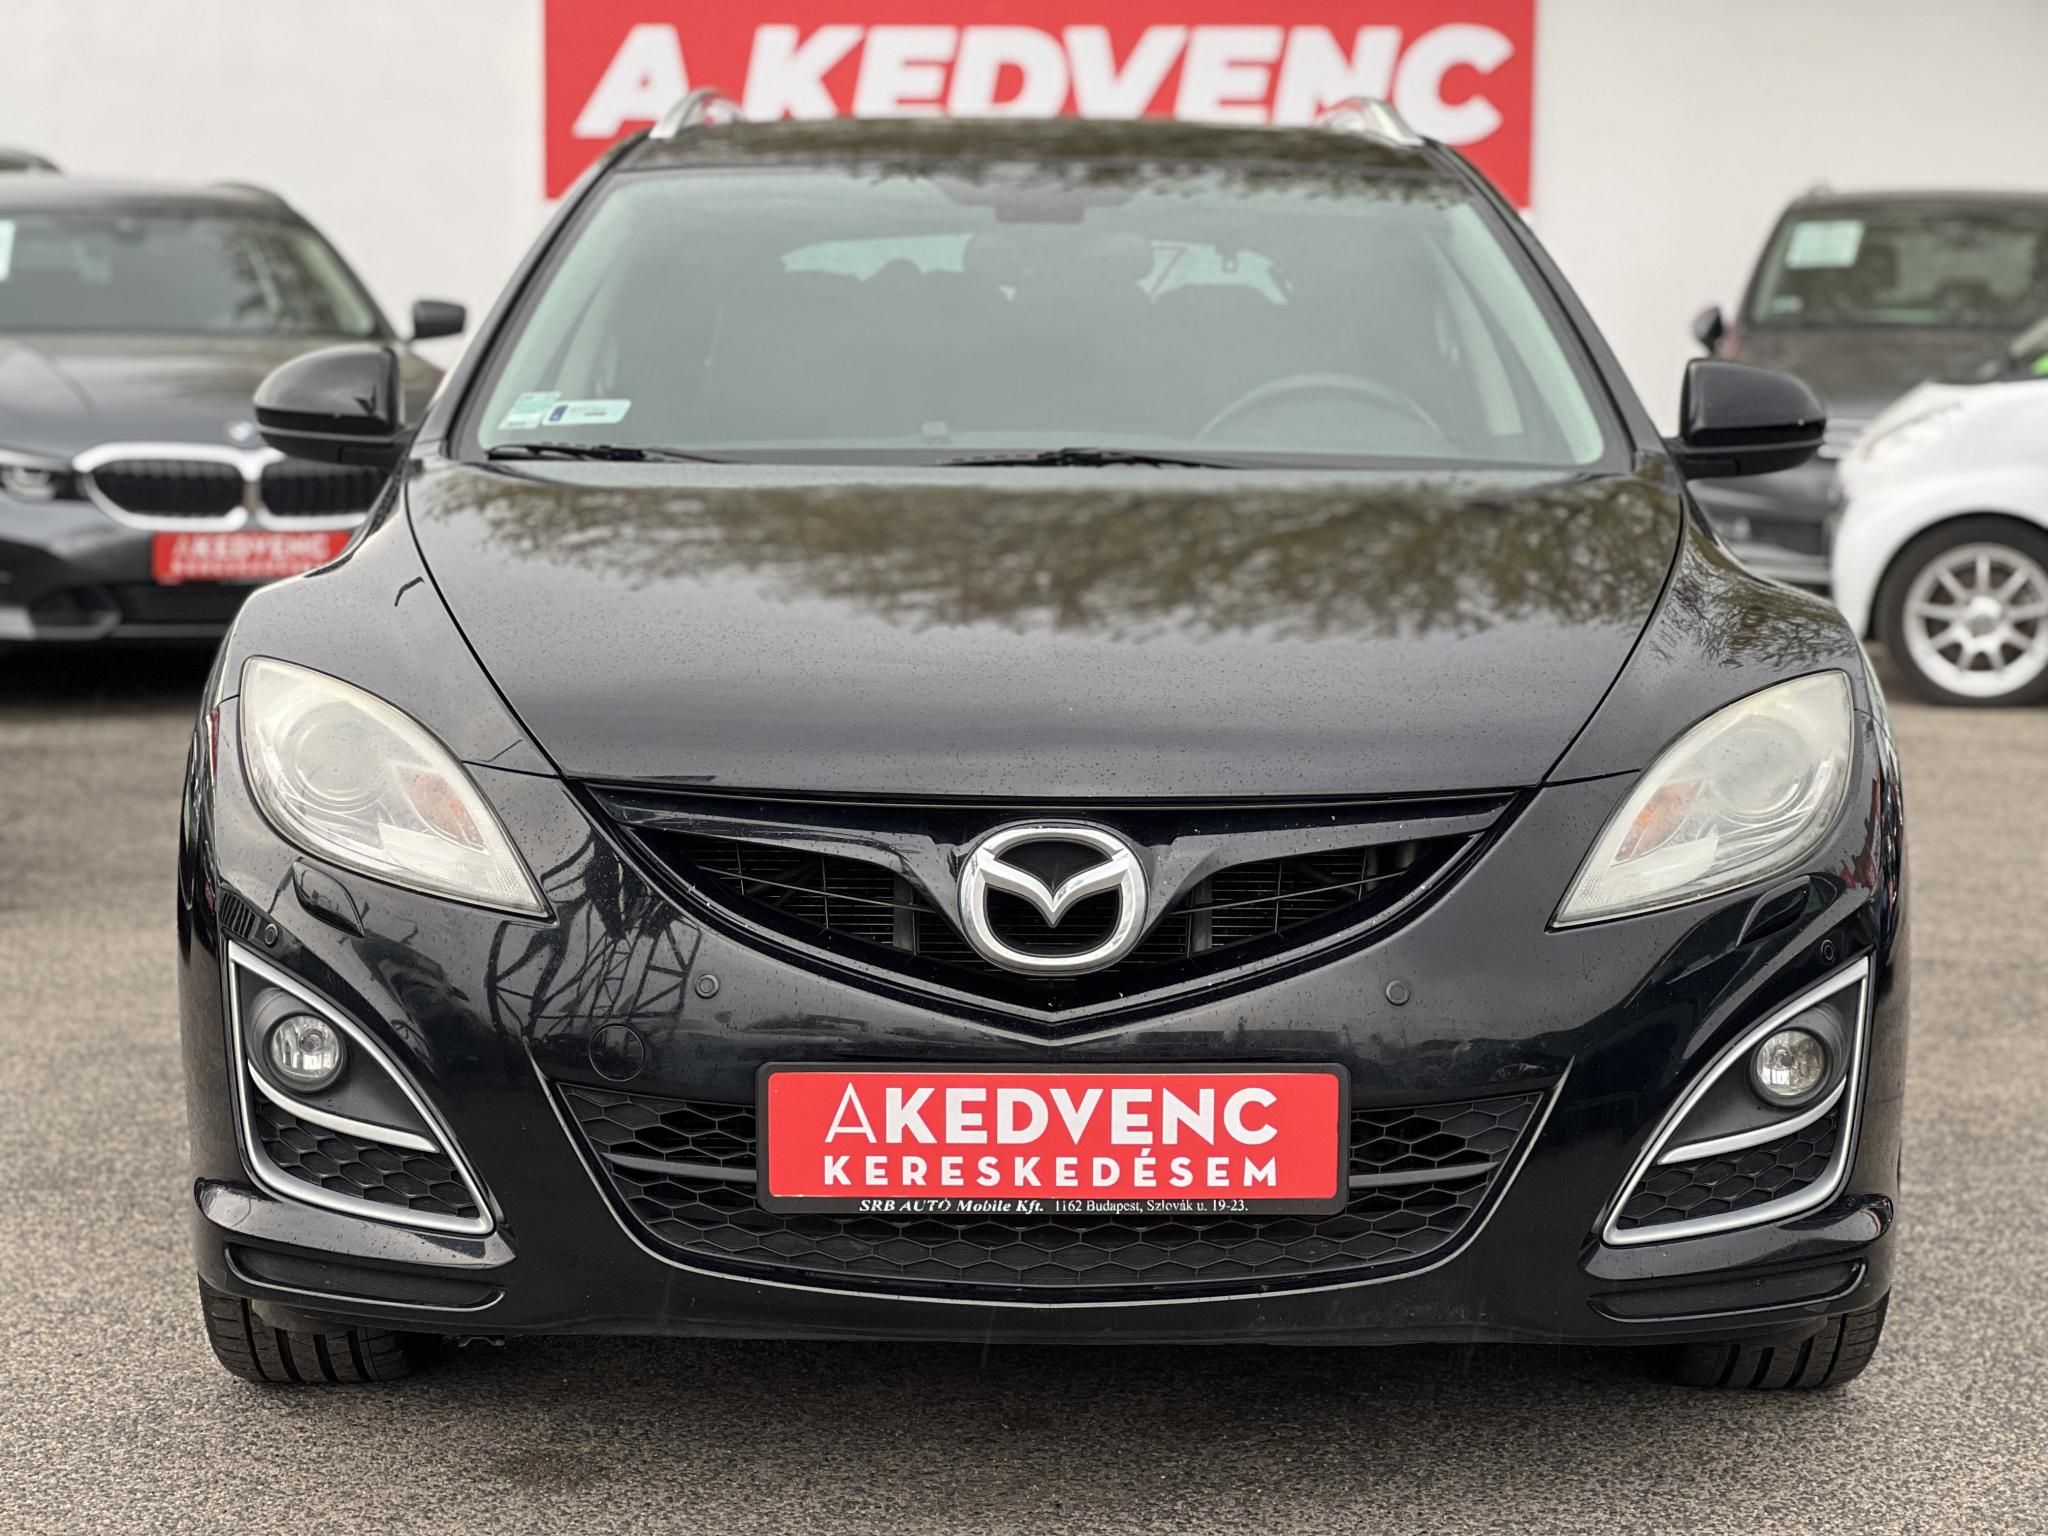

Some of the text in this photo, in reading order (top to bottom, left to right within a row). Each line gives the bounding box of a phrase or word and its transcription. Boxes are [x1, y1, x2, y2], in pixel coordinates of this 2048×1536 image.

[571, 22, 1514, 147] A KEDVENC
[824, 1147, 1277, 1188] KERESKEDÉSEM
[858, 1199, 896, 1212] SRB
[956, 1199, 1012, 1212] Mobile
[1015, 1199, 1045, 1215] Kft.
[1055, 1199, 1082, 1212] 1162
[1085, 1199, 1144, 1215] Budapest,
[1146, 1198, 1193, 1212] Szlovák
[1196, 1202, 1208, 1212] u.
[1212, 1199, 1249, 1212] 19-23.
